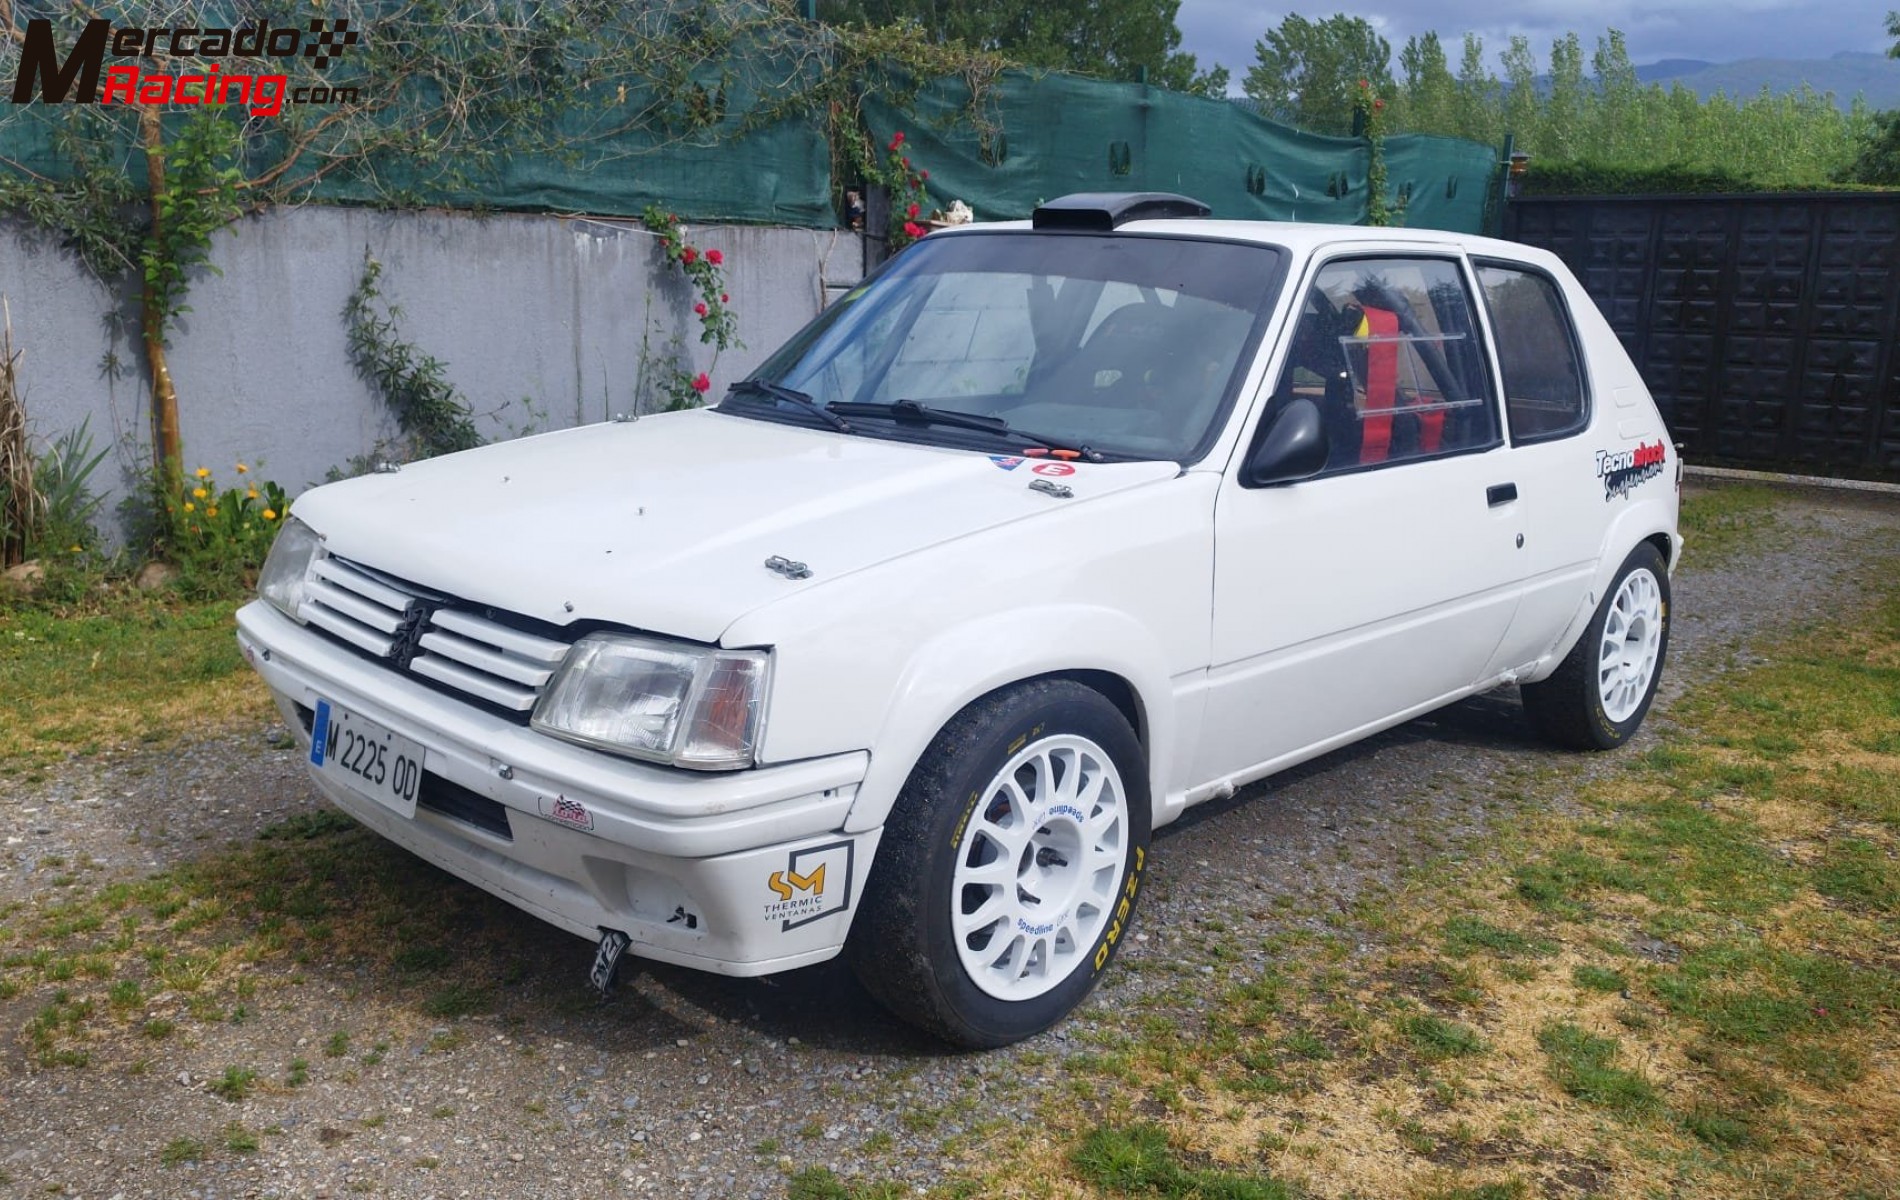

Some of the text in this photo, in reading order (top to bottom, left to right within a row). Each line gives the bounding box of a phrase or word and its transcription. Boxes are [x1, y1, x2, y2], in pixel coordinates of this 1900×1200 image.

[325, 720, 340, 760] M
[340, 729, 388, 785] 2225
[764, 896, 823, 914] THERMIC
[764, 906, 822, 921] VENTANAS
[1095, 871, 1138, 971] ZERO
